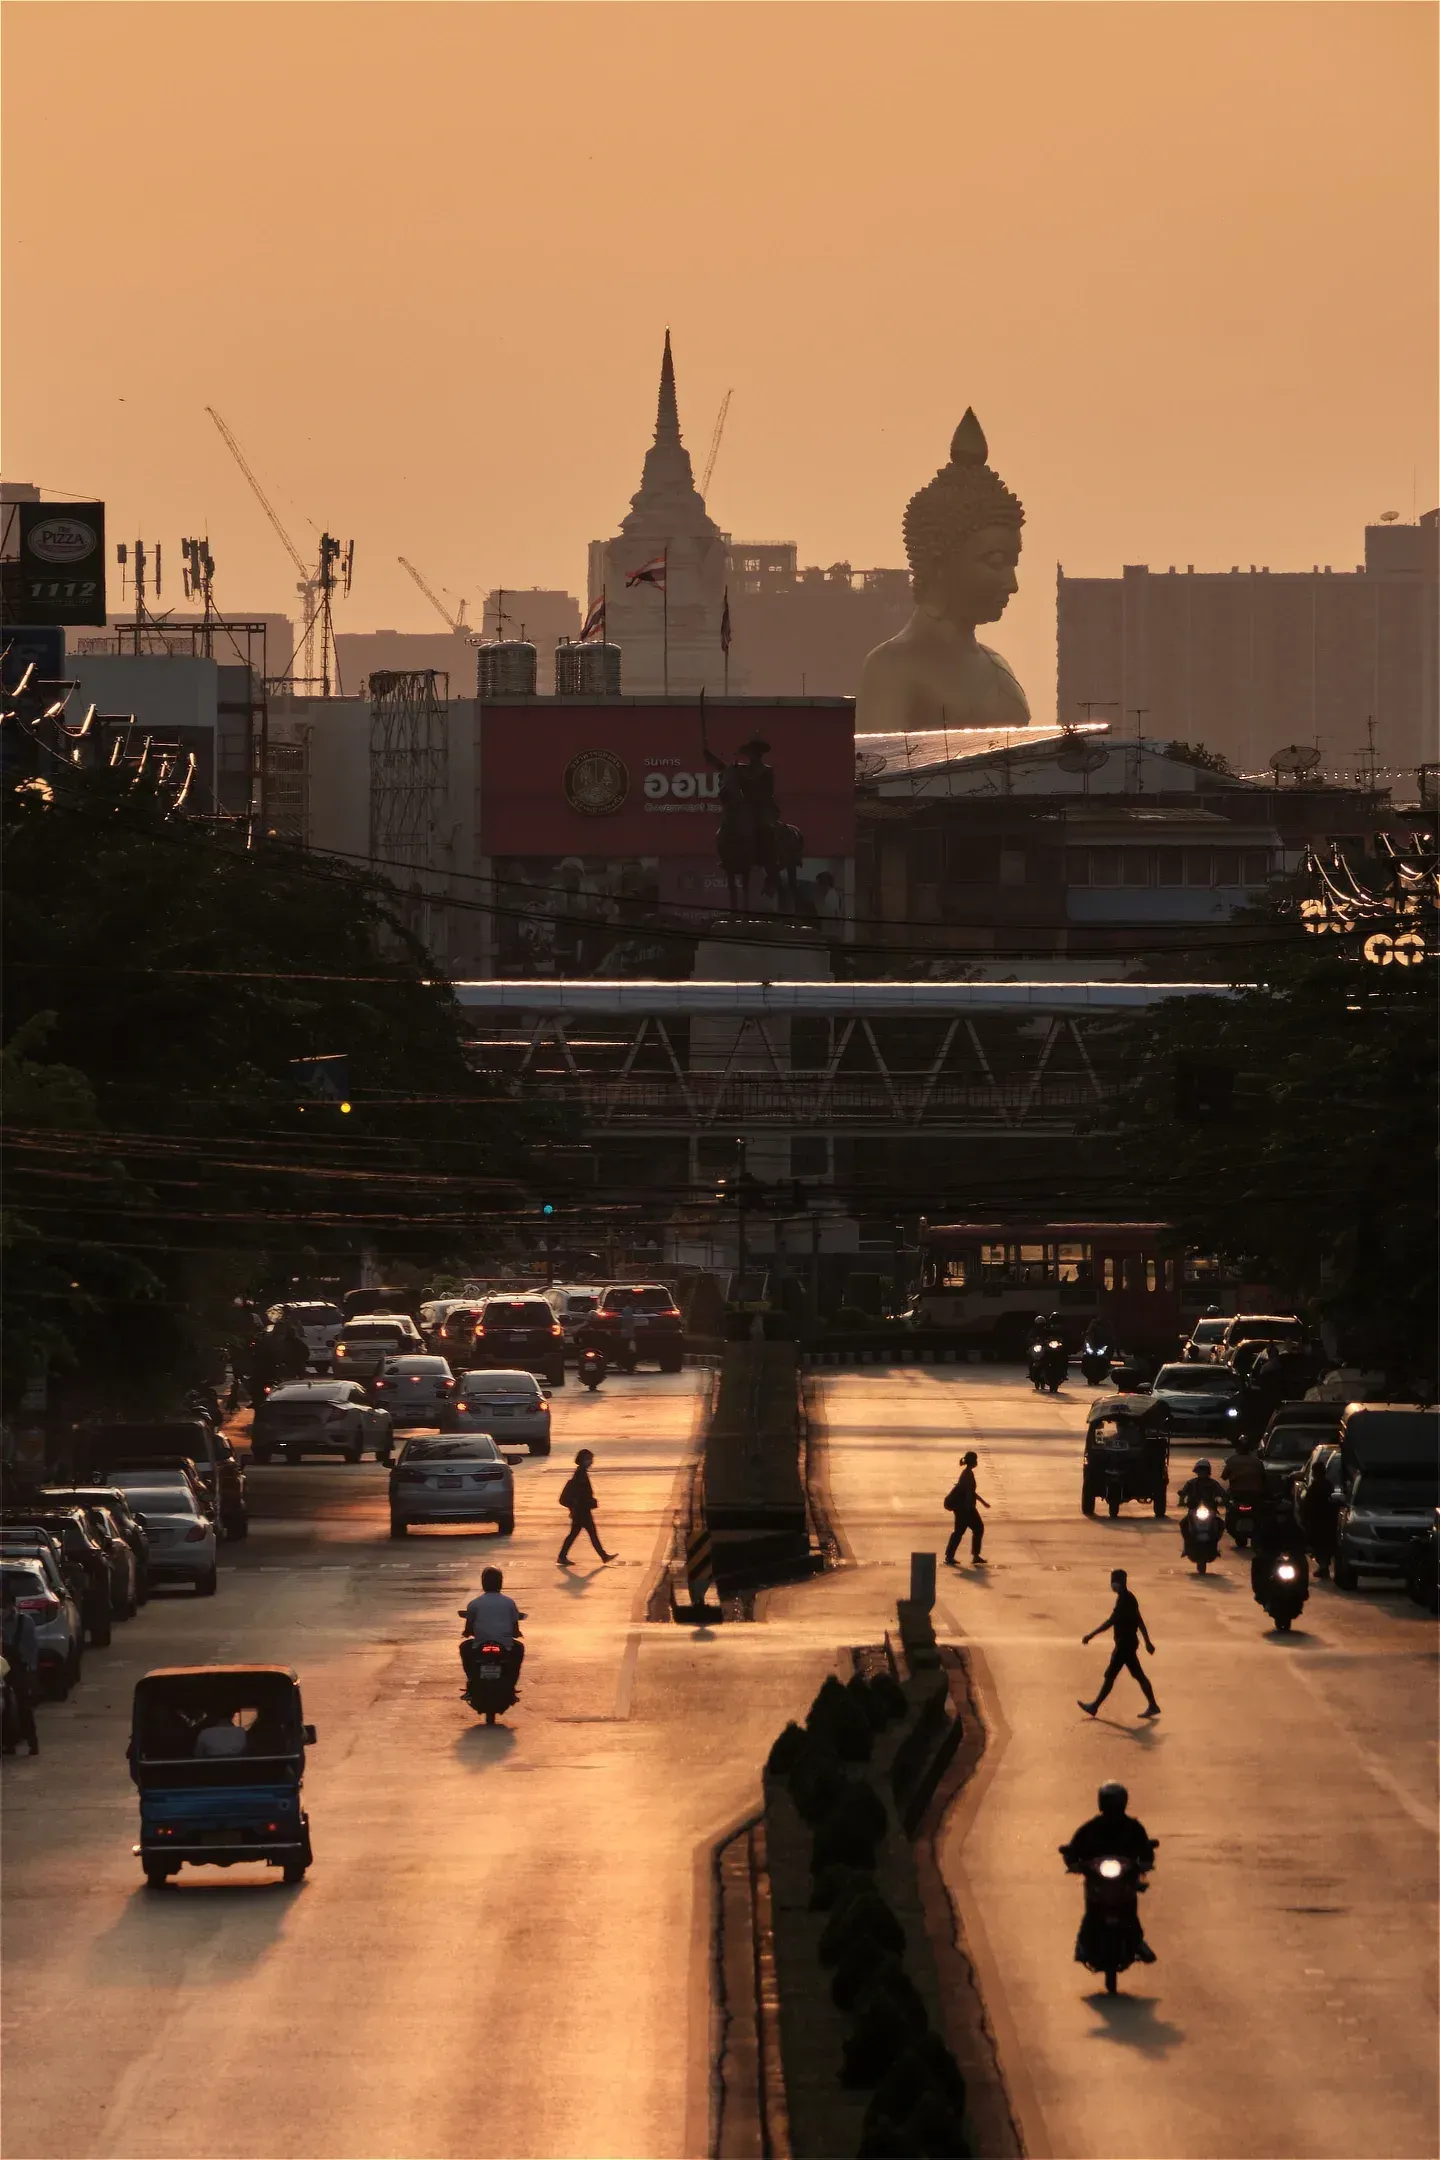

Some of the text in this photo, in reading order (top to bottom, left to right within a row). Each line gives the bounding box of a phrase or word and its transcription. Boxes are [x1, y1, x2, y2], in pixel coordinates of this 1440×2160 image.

[42, 530, 84, 545] PIZZA
[30, 582, 97, 597] 1112
[644, 757, 681, 767] ธนาคาร
